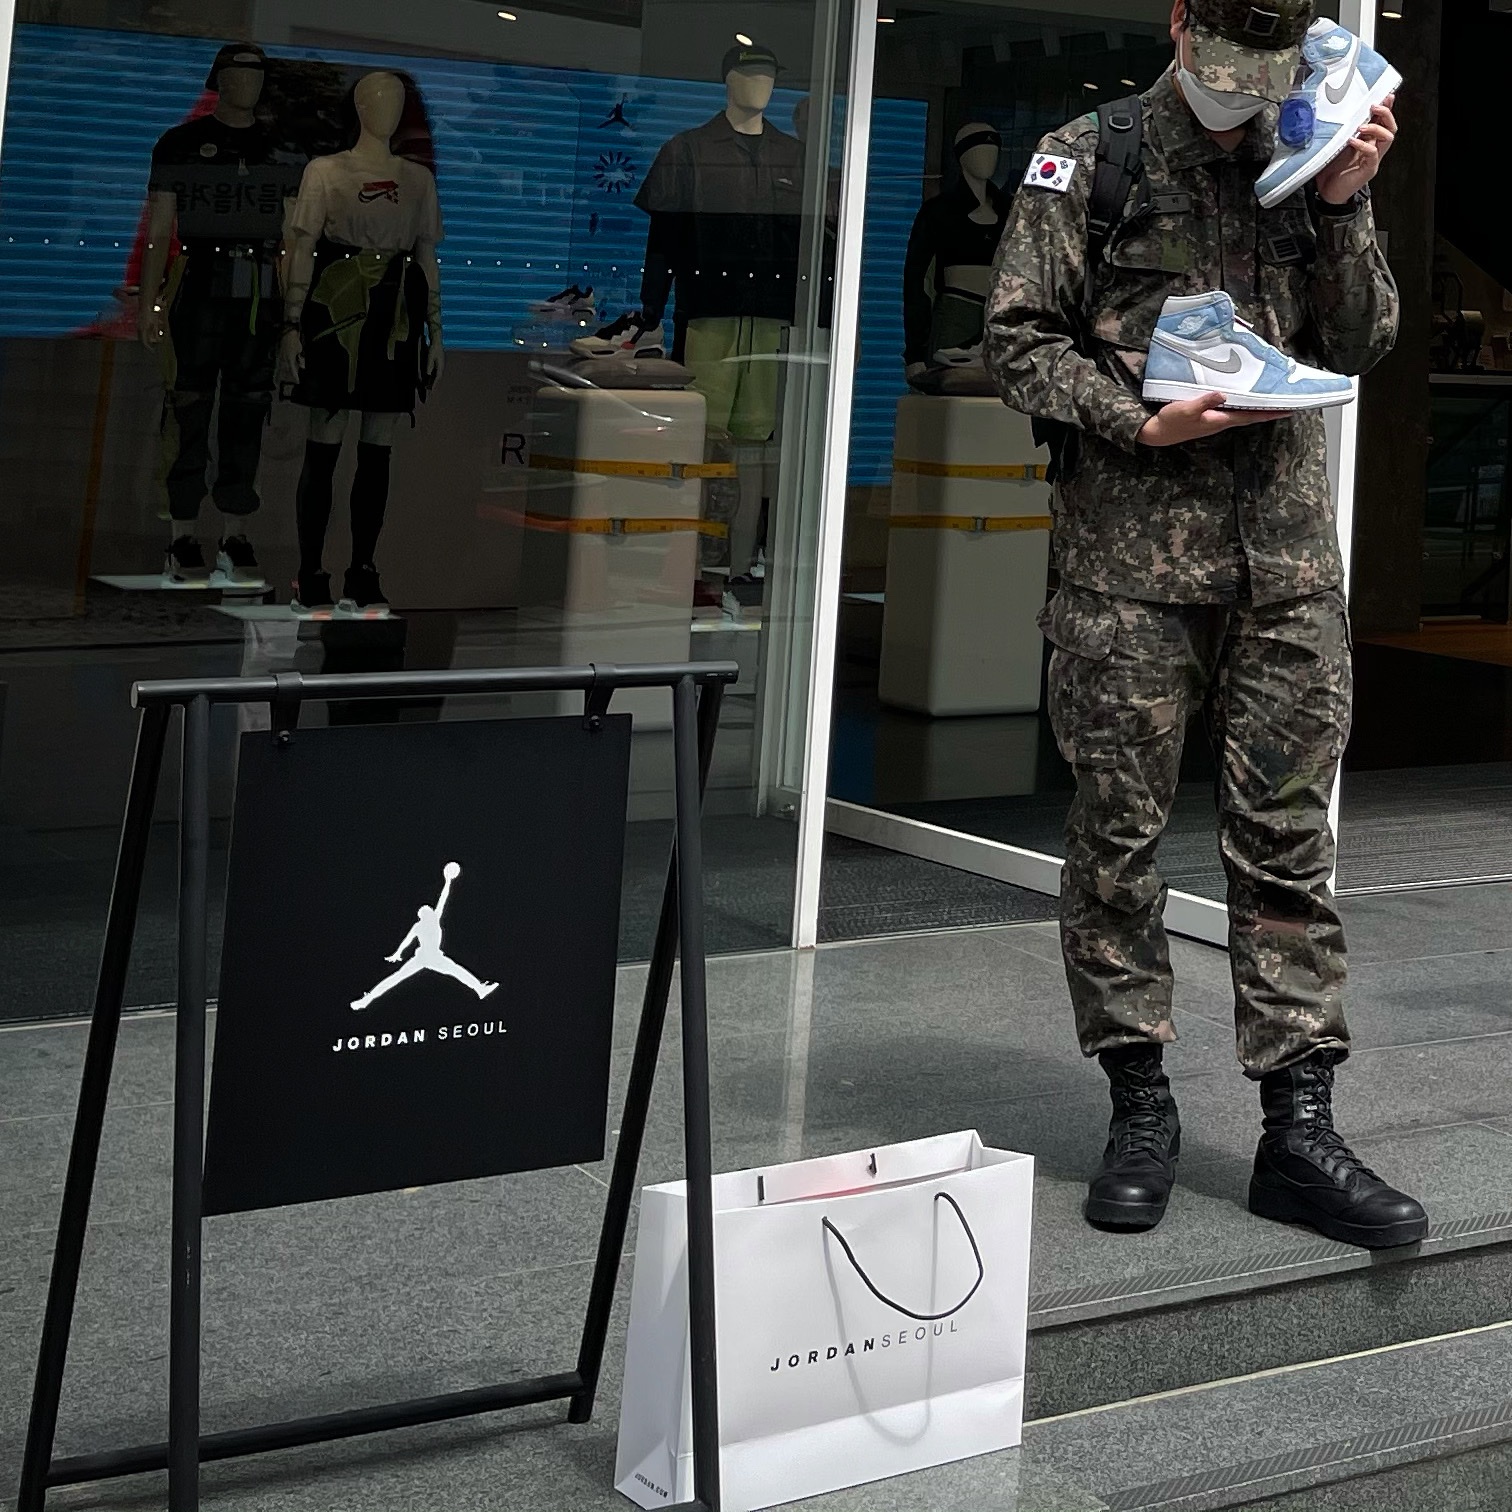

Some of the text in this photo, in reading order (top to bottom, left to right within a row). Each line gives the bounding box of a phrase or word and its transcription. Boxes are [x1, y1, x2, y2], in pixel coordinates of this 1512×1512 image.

[501, 432, 526, 465] R
[332, 1020, 508, 1052] JORDAN SEOUL
